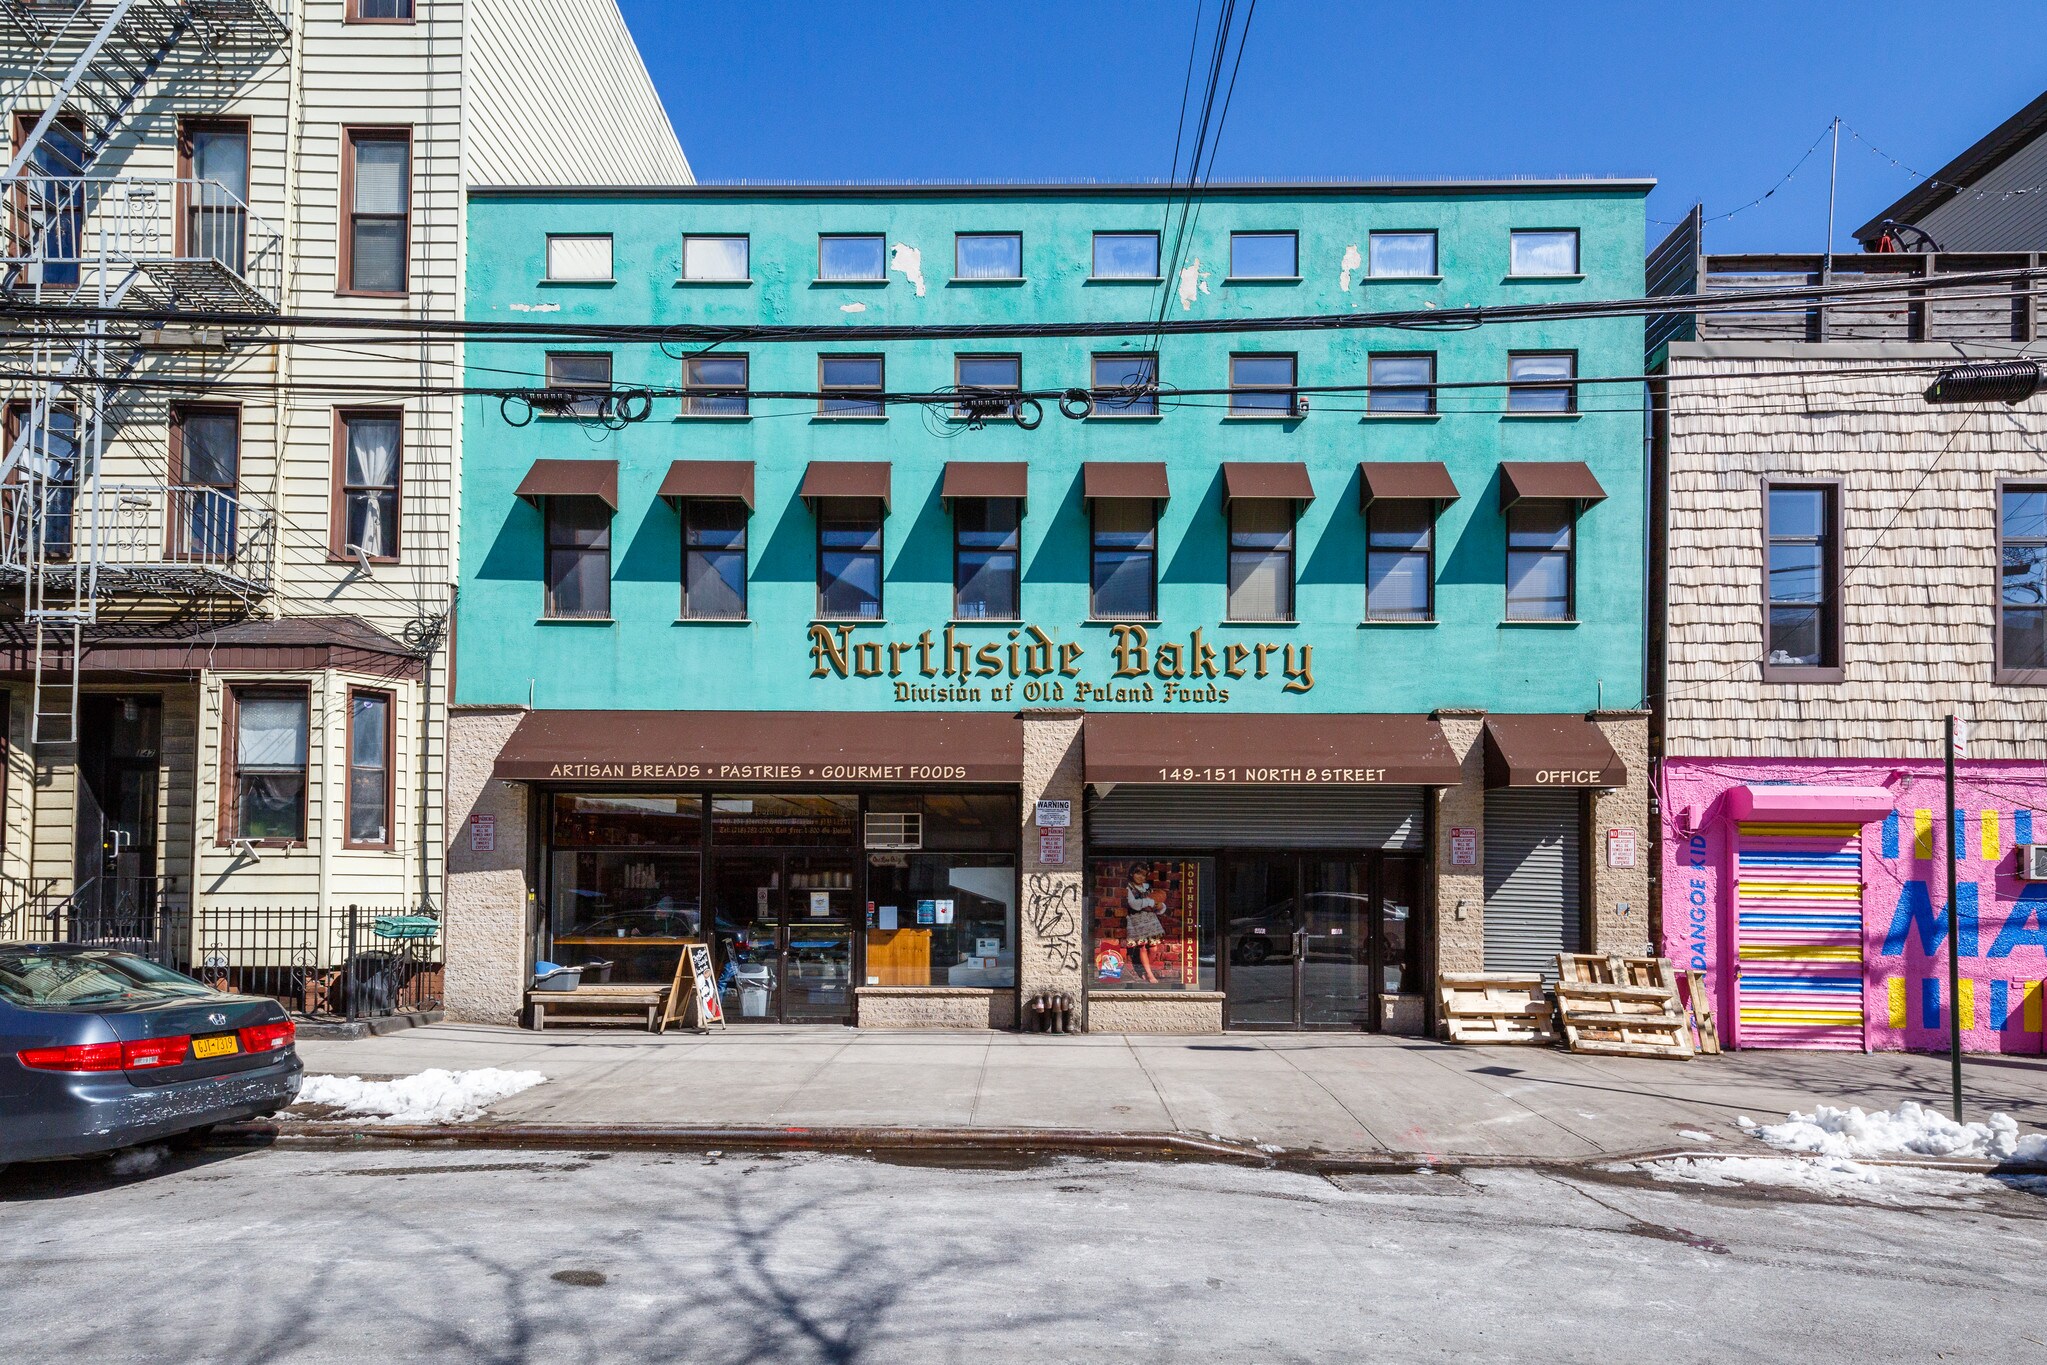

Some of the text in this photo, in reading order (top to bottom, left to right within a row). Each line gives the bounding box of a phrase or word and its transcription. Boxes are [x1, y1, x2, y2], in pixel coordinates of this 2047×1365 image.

[808, 624, 1315, 694] Northside Bakery
[894, 681, 1230, 703] Division of Old Poland Foods
[550, 764, 966, 779] ARTISAN BREADS PASTRIES GOURMET FOODS
[1158, 768, 1386, 782] 149-151 NORTH 8 STREET
[1535, 770, 1601, 783] OFFICE
[1690, 835, 1706, 871] KID
